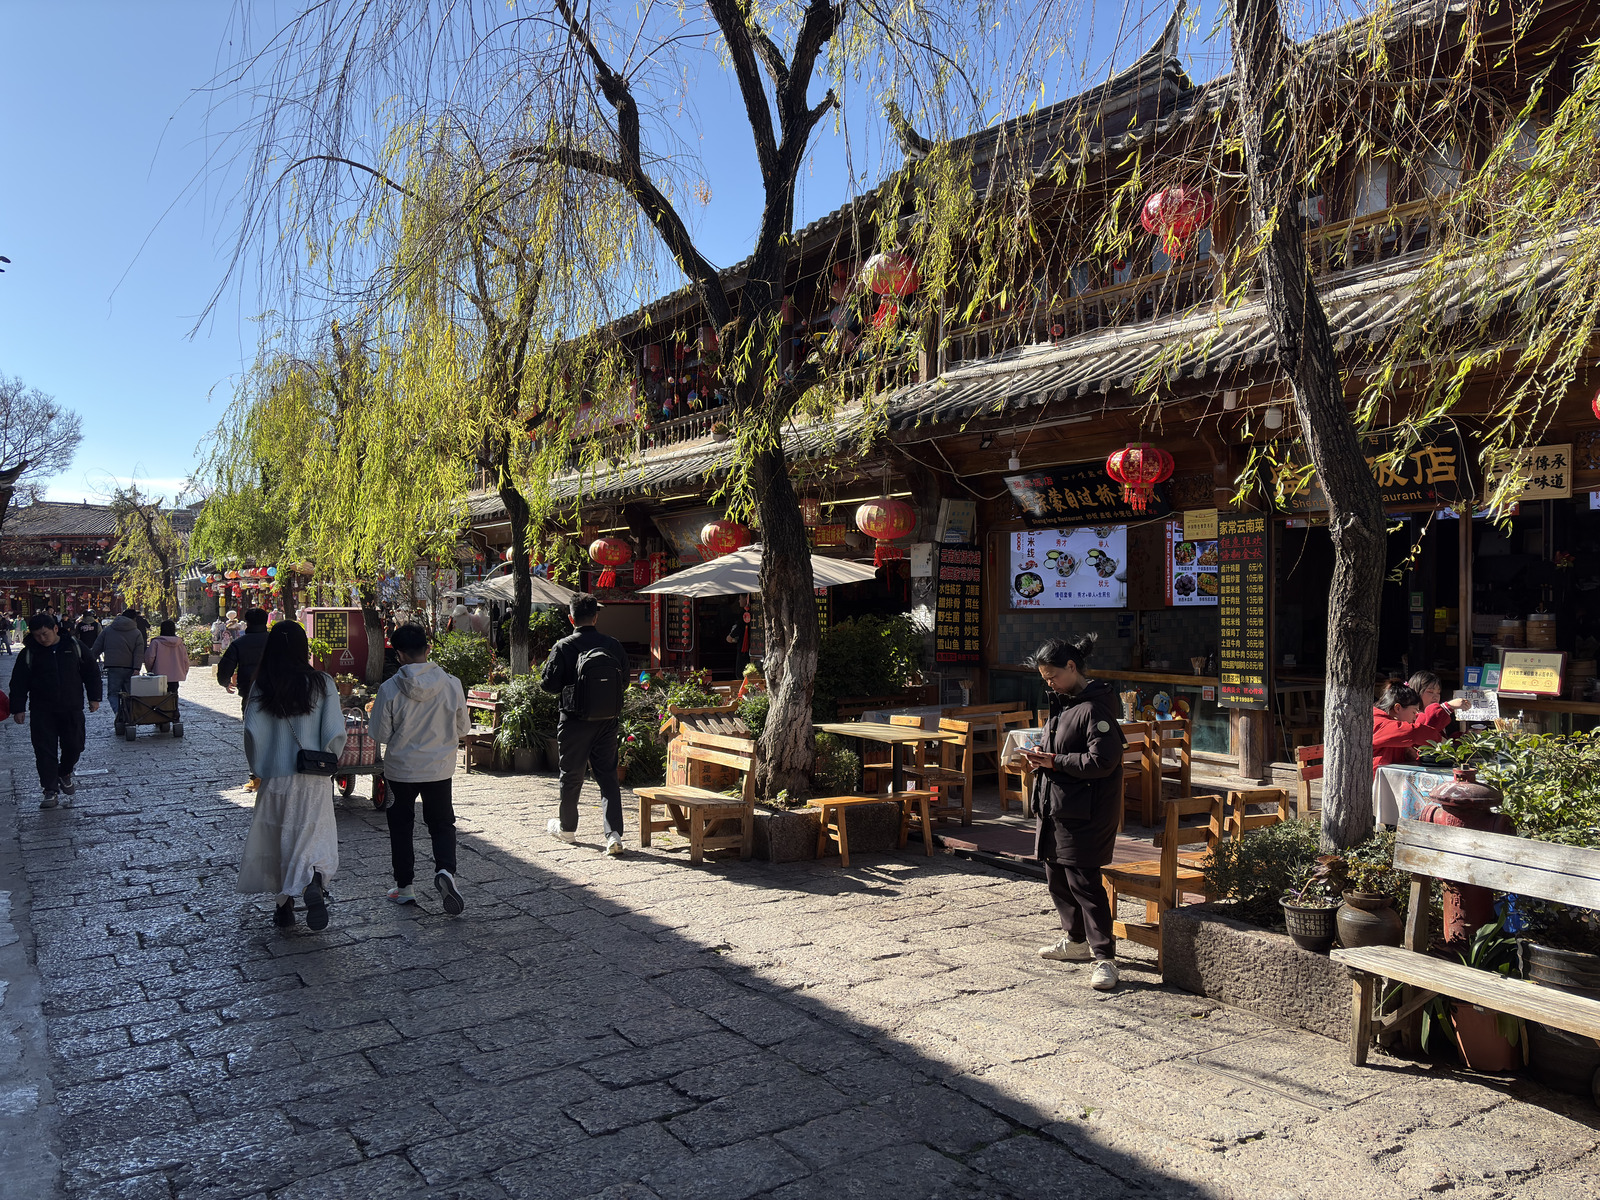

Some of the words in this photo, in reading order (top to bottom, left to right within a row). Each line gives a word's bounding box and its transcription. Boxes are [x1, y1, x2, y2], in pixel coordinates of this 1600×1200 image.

[1270, 446, 1458, 496] 盛饭店
[1019, 484, 1161, 513] 正宗蒙自过桥
[1292, 496, 1326, 510] Sheng
[1383, 490, 1422, 502] aurant
[1219, 518, 1264, 535] 家常云南菜
[1056, 539, 1067, 547] 秀才
[940, 548, 981, 565] 云南过桥米线
[1221, 564, 1240, 572] 卤汁鸡腿
[1221, 575, 1240, 583] 番茄炒蛋
[937, 611, 960, 622] 野生菌
[964, 625, 979, 637] 炒饭
[1221, 628, 1240, 637] 宫保鸡丁
[964, 639, 979, 650] 盖饭
[1221, 639, 1240, 648] 土豆牛肉
[1221, 650, 1245, 658] 铁板黄牛肉
[1464, 691, 1484, 699] 招聘
[1472, 700, 1497, 710] 员二名
